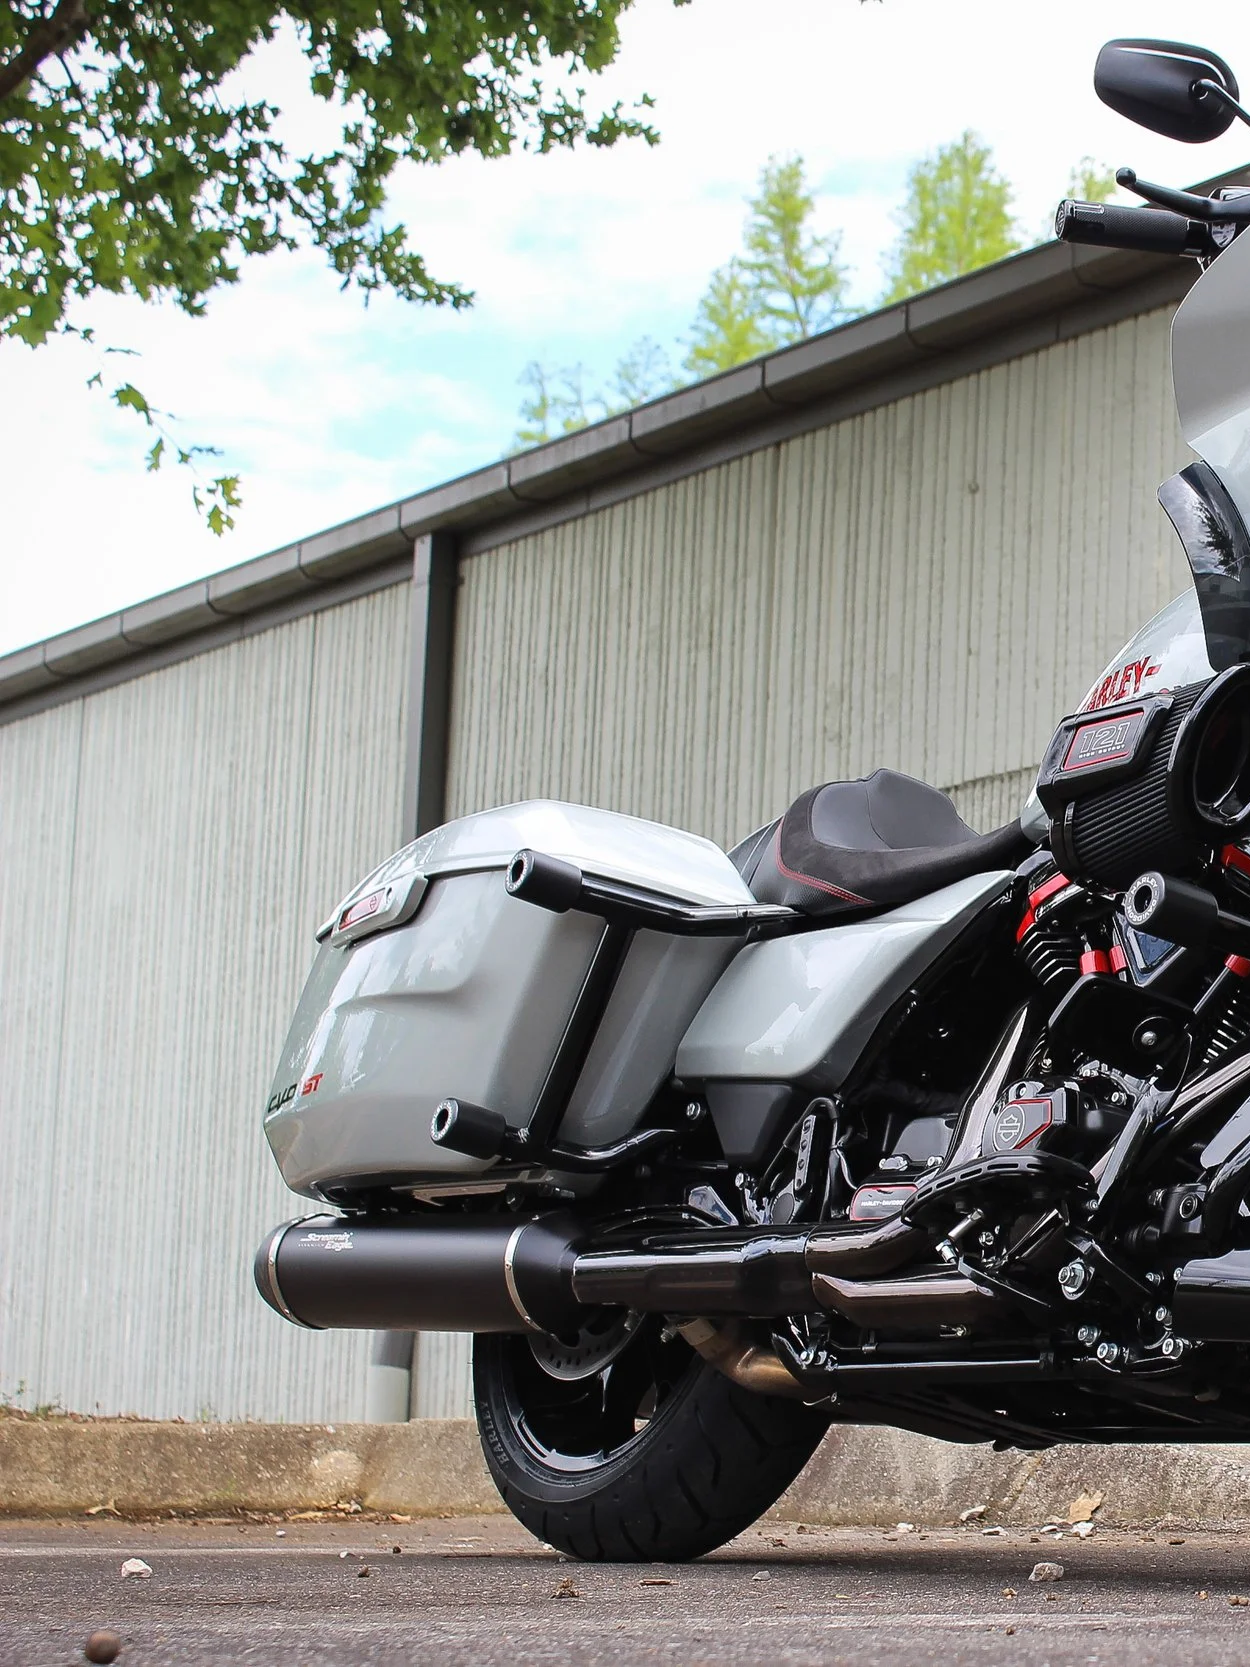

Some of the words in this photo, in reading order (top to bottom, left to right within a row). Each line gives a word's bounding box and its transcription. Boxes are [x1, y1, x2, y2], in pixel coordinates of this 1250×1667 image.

[1084, 654, 1162, 711] ARLEY-
[1080, 721, 1131, 753] 121
[301, 1072, 324, 1097] ST
